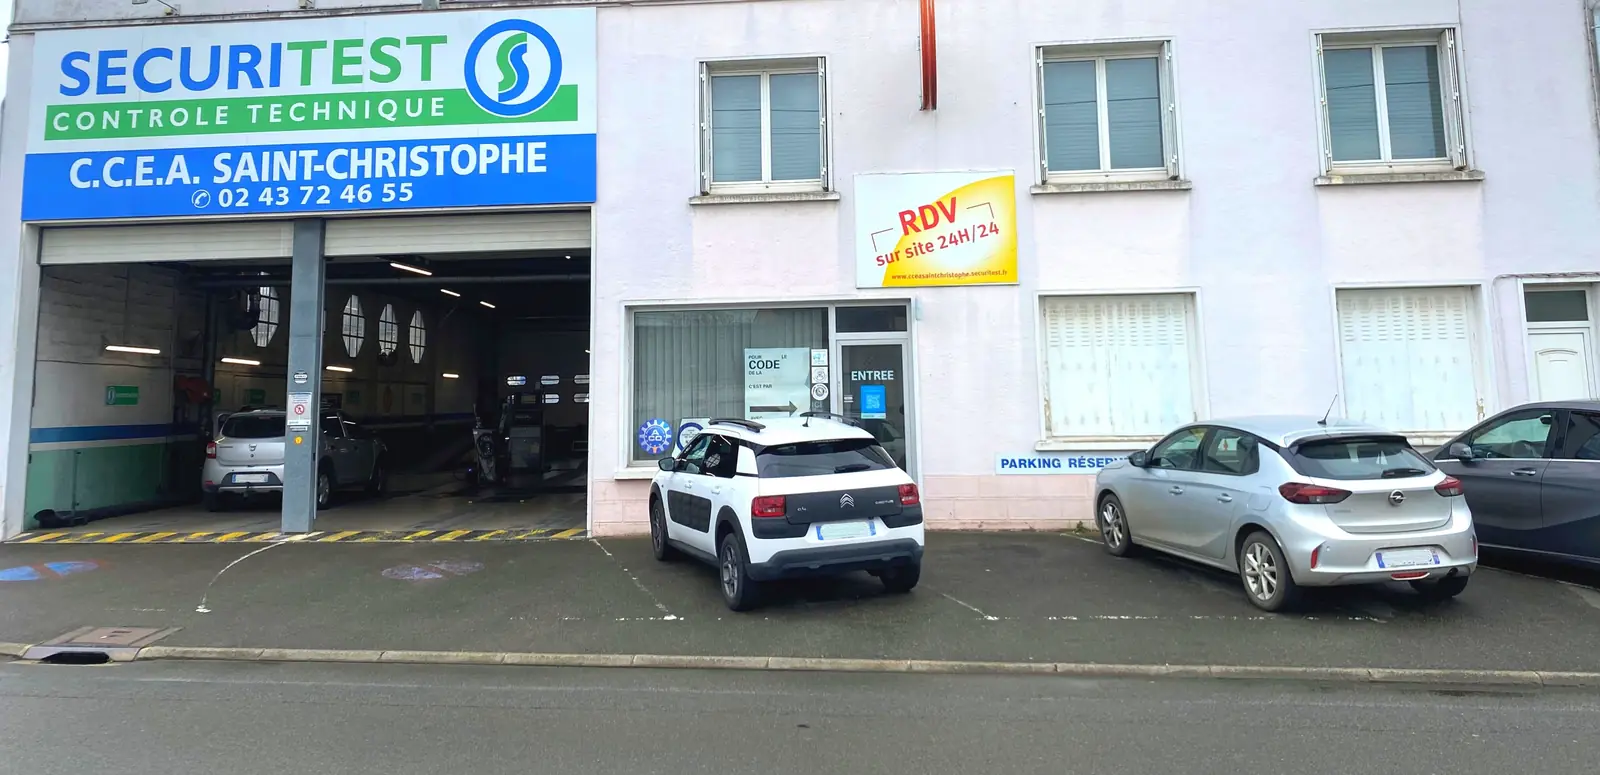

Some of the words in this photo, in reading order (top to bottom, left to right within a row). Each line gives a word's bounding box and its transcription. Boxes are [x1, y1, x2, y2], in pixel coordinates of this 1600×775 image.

[60, 34, 447, 97] SECURITEST
[53, 106, 229, 131] CONTROLE
[247, 97, 444, 124] TECHNIQUE
[69, 154, 200, 189] C.C.E.A.
[213, 141, 547, 184] SAINT-CHRISTOPHE
[218, 188, 249, 208] 02
[258, 186, 290, 206] 43
[300, 185, 331, 205] 72
[340, 184, 372, 203] 46
[381, 182, 413, 202] 55
[898, 197, 957, 236] RDV
[876, 250, 901, 267] sur
[905, 241, 936, 259] site
[937, 222, 1000, 249] 24H/24
[748, 360, 780, 370] CODE
[851, 370, 894, 381] ENTREE
[1001, 458, 1061, 469] PARKING
[1068, 456, 1129, 468] RÉSER
